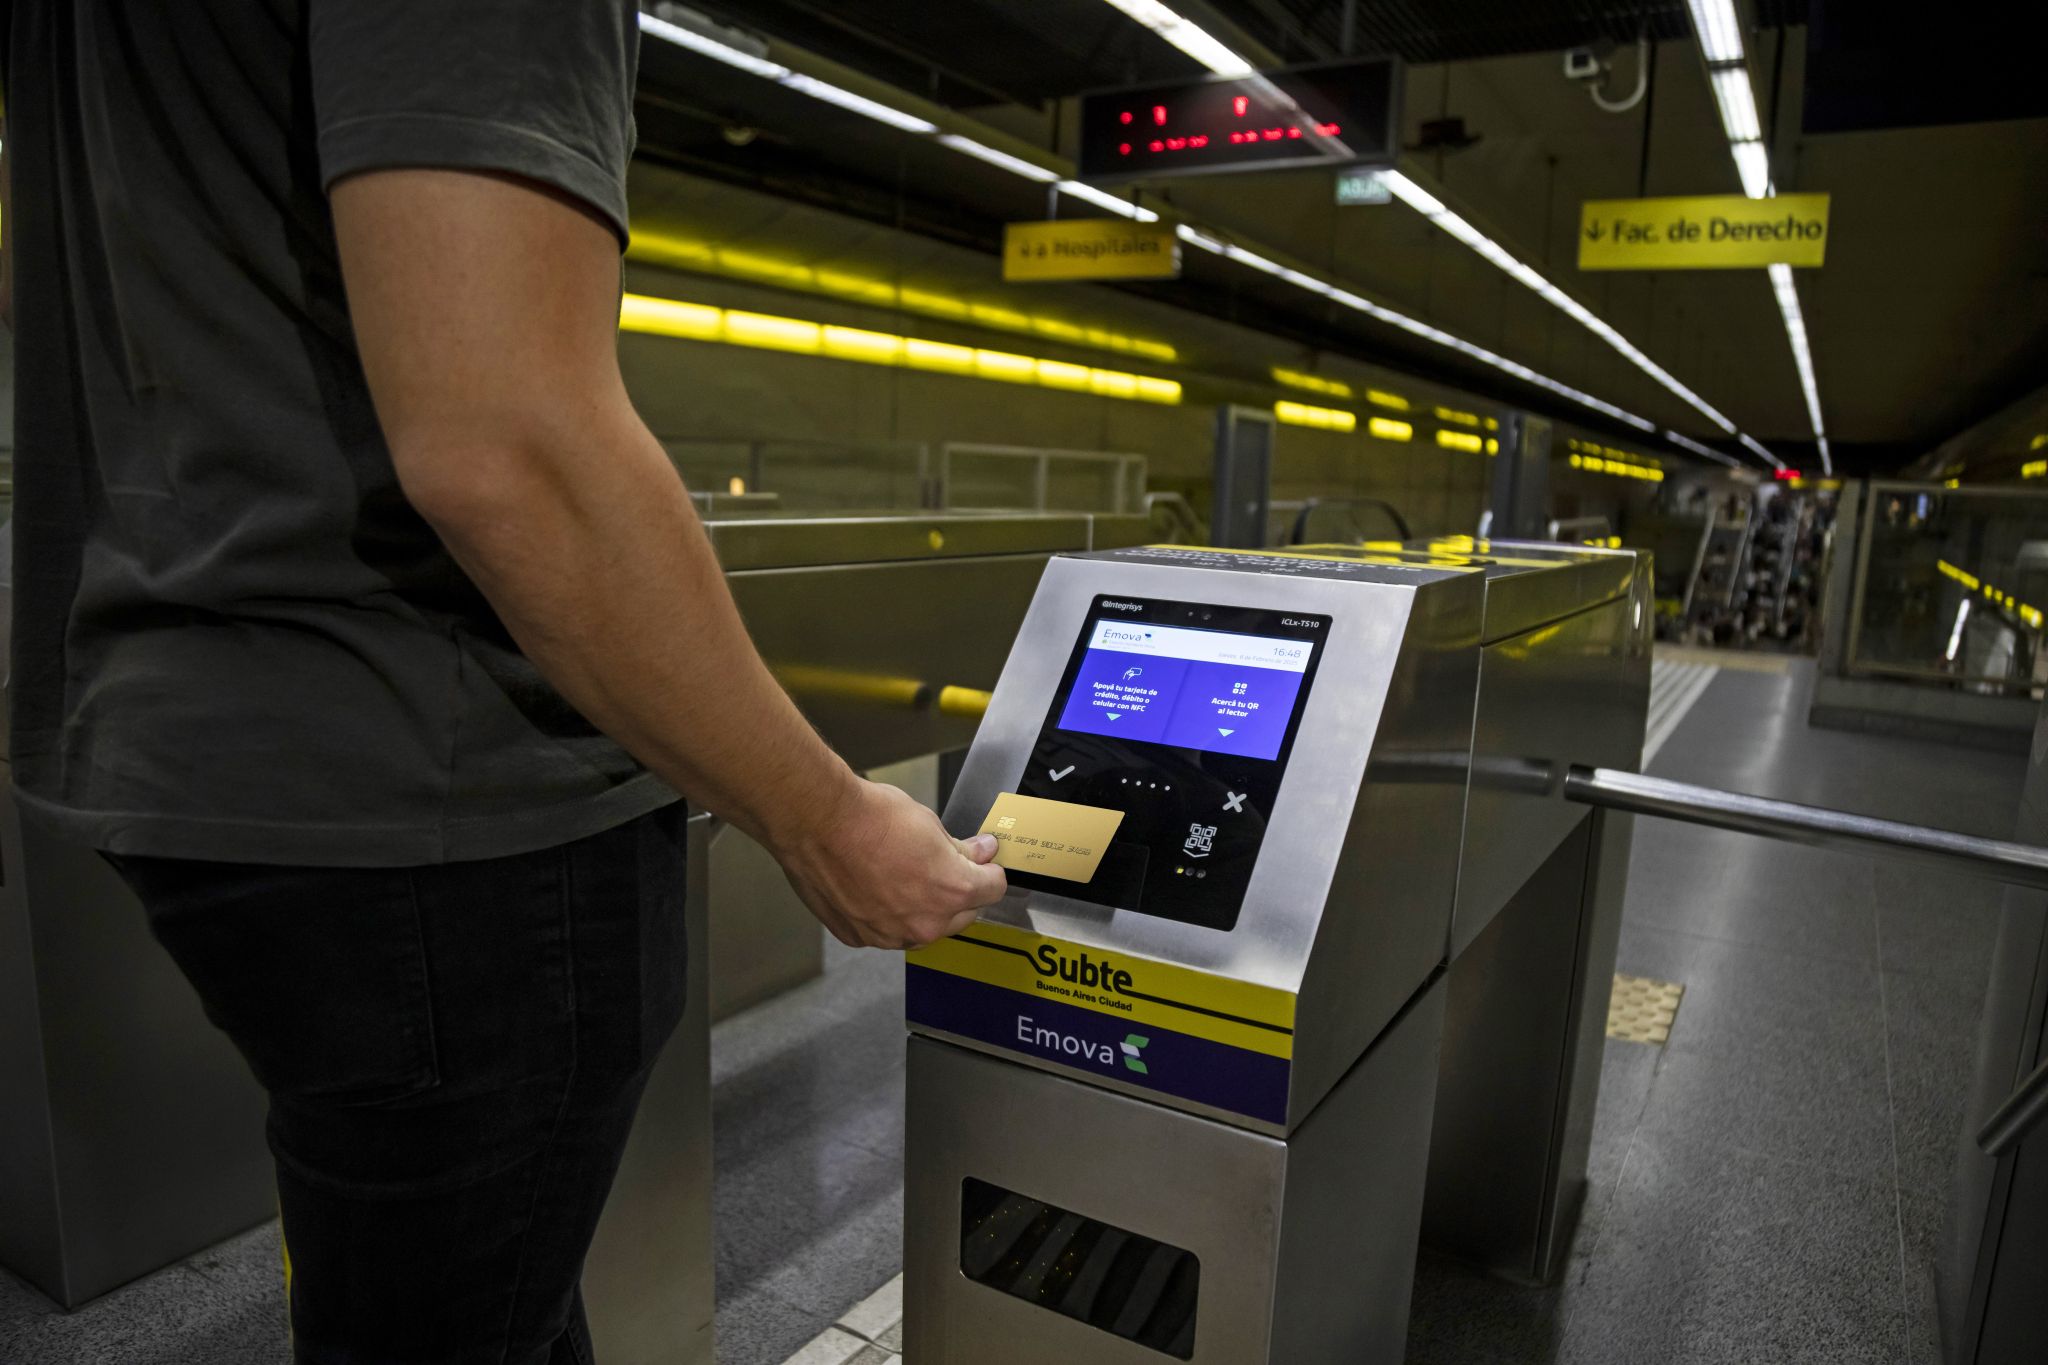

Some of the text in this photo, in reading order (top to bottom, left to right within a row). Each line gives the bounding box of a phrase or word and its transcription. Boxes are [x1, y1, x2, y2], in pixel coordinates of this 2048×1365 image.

[1613, 212, 1822, 242] Fac. de Derecho
[1103, 628, 1142, 642] Emova
[1273, 647, 1302, 659] 16:48
[1124, 686, 1148, 695] tarjeta
[1148, 688, 1158, 696] de
[1121, 694, 1144, 703] débito
[1211, 697, 1237, 707] Acercá
[1247, 702, 1260, 710] QR
[1092, 699, 1116, 708] celular
[1130, 704, 1146, 712] NFC
[1226, 708, 1249, 717] lector
[1037, 944, 1133, 996] Subte
[1036, 980, 1133, 1012] Buenos Aires Ciudad
[1017, 1015, 1114, 1065] Emova
